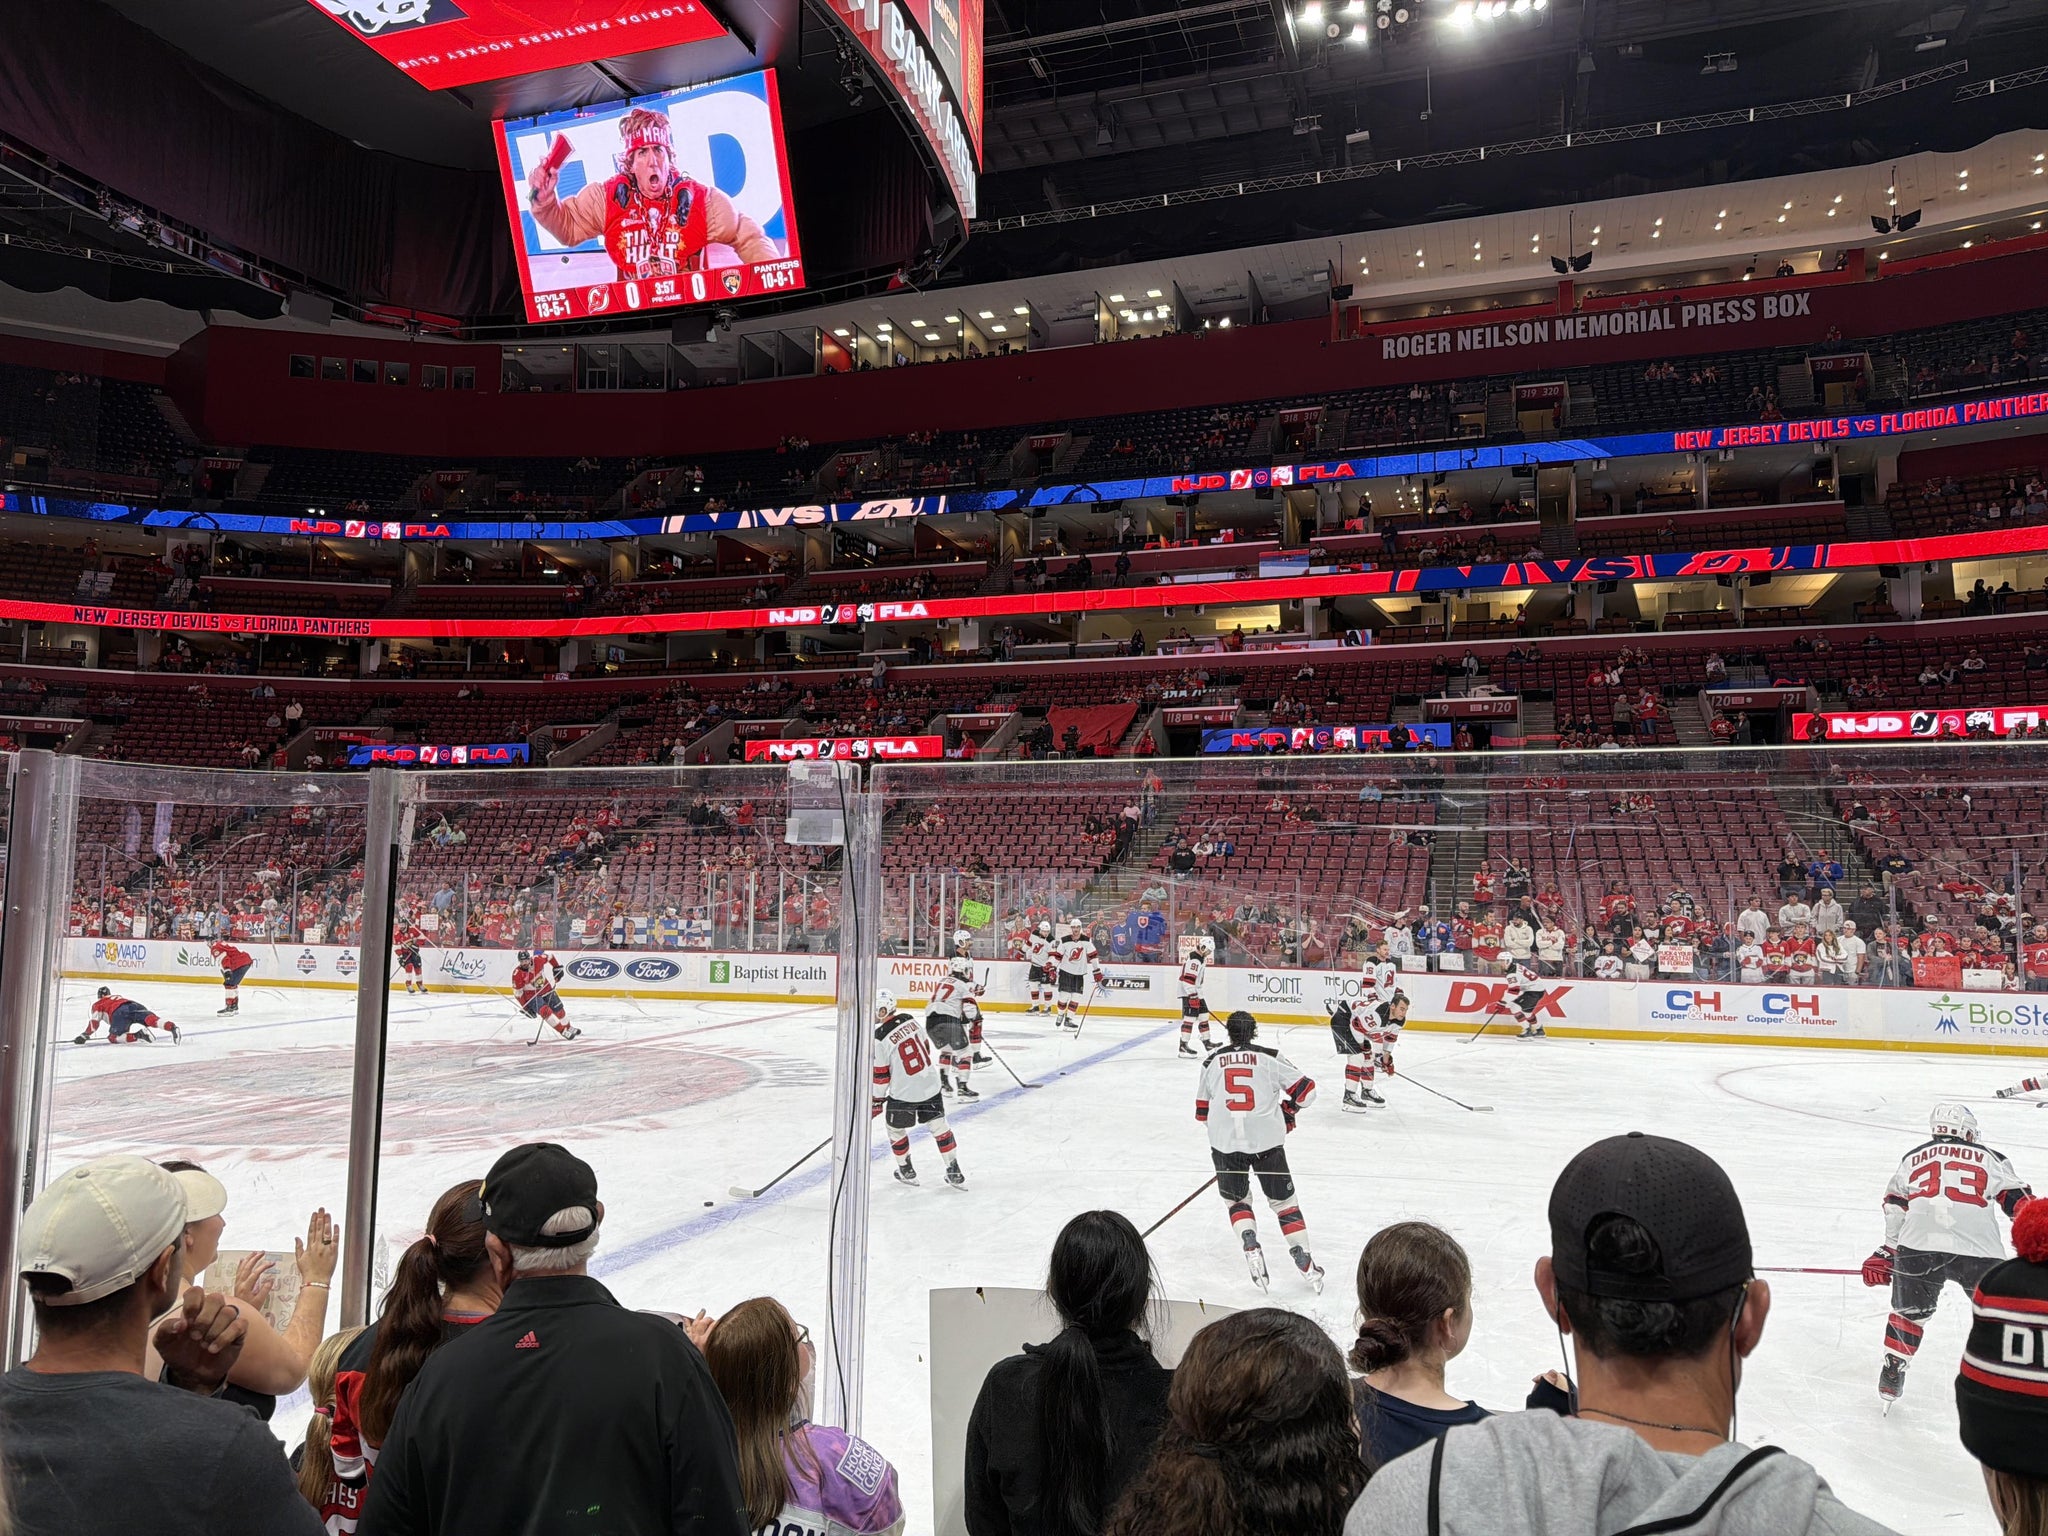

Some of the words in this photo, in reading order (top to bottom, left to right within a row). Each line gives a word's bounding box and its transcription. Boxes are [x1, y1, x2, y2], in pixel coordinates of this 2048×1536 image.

[617, 3, 695, 26] FLORIDA
[519, 20, 610, 45] PANTHERS
[447, 41, 512, 60] HOCKEY
[397, 54, 439, 69] CLUB
[754, 260, 800, 274] PANTHERS
[655, 280, 675, 294] 3:57
[691, 274, 706, 300] 0
[761, 272, 794, 289] 10-8-1
[534, 293, 566, 303] DEVILS
[625, 283, 640, 309] 0
[536, 301, 571, 318] 13-5-1
[1382, 332, 1451, 359] ROGER
[1457, 321, 1549, 351] NEILSON
[1555, 307, 1676, 341] MEMORIAL
[1682, 298, 1756, 328] PRESS
[1763, 292, 1811, 320] BOX
[1815, 361, 1833, 370] 320
[1520, 389, 1537, 398] 319
[1542, 387, 1559, 396] 320
[1283, 414, 1298, 423] 318
[1674, 431, 1712, 450] NEW
[1718, 424, 1782, 446] JERSEY
[1788, 419, 1850, 441] DEVILS
[1881, 406, 1958, 433] FLORIDA
[1172, 475, 1225, 491] NJD
[1298, 463, 1355, 480] FLA
[760, 505, 825, 527] VS
[290, 519, 341, 533] NJD
[404, 524, 450, 537] FLA
[74, 608, 107, 623] NEW
[114, 611, 167, 626] JERSEY
[172, 613, 219, 628] DEVILS
[244, 617, 298, 632] FLORIDA
[304, 620, 370, 634] PANTHERS
[769, 609, 816, 623] NJD
[880, 603, 928, 618] FLA
[1431, 704, 1449, 715] 119
[1492, 702, 1512, 713] 120
[1709, 695, 1731, 706] 120
[1167, 713, 1181, 723] 118
[1832, 717, 1902, 734] NJD
[555, 729, 569, 739] 115
[1232, 732, 1287, 747] NJD
[371, 749, 416, 761] NJD
[470, 748, 509, 760] FLA
[769, 743, 813, 757] NJD
[96, 942, 146, 961] BROWARD
[117, 960, 146, 968] COUNTY
[576, 960, 610, 977] Ford
[635, 960, 670, 978] Ford
[733, 965, 778, 982] Baptist
[782, 966, 827, 980] Health
[1106, 979, 1122, 987] Air
[1123, 979, 1146, 988] Pros
[1248, 973, 1264, 983] THE
[1262, 977, 1302, 995] JOINT
[1247, 995, 1302, 1004] chiropractic
[1666, 990, 1721, 1012] CH
[1762, 993, 1819, 1016] CH
[1651, 1011, 1687, 1021] Cooper
[1703, 1012, 1738, 1021] Hunter
[1747, 1014, 1784, 1024] Cooper
[1801, 1016, 1837, 1026] Hunter
[1219, 1053, 1257, 1068] DILLON
[1224, 1068, 1255, 1112] 5
[1936, 1125, 1948, 1134] 33
[1912, 1146, 1984, 1167] DADONOV
[1908, 1160, 1988, 1208] 33
